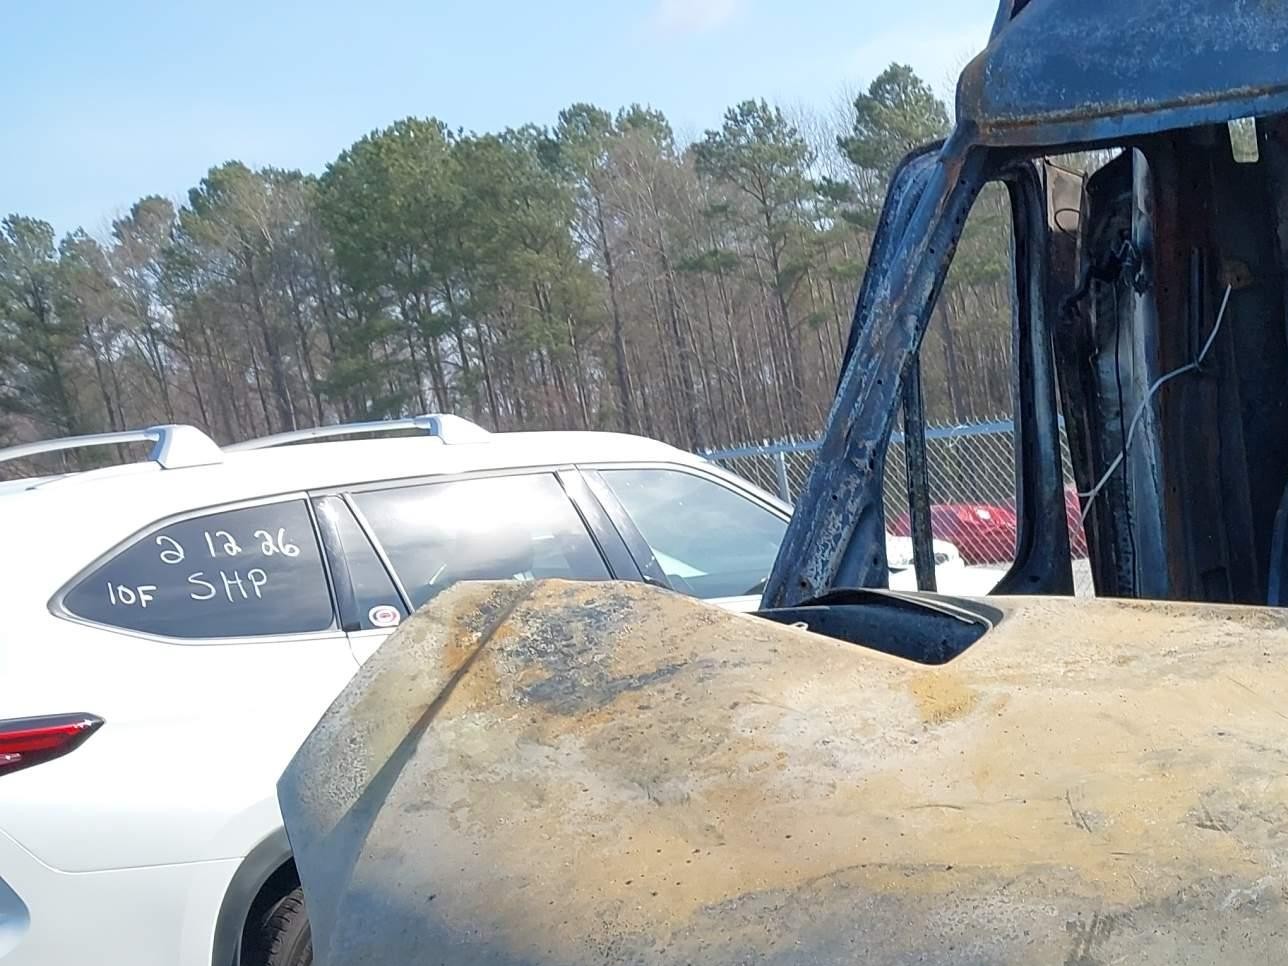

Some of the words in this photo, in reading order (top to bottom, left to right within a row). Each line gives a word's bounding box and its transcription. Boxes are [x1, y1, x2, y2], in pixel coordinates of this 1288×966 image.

[155, 535, 185, 564] 2
[204, 531, 242, 558] 12
[253, 528, 301, 558] 26
[107, 582, 158, 608] 10F
[187, 568, 268, 602] SHP
